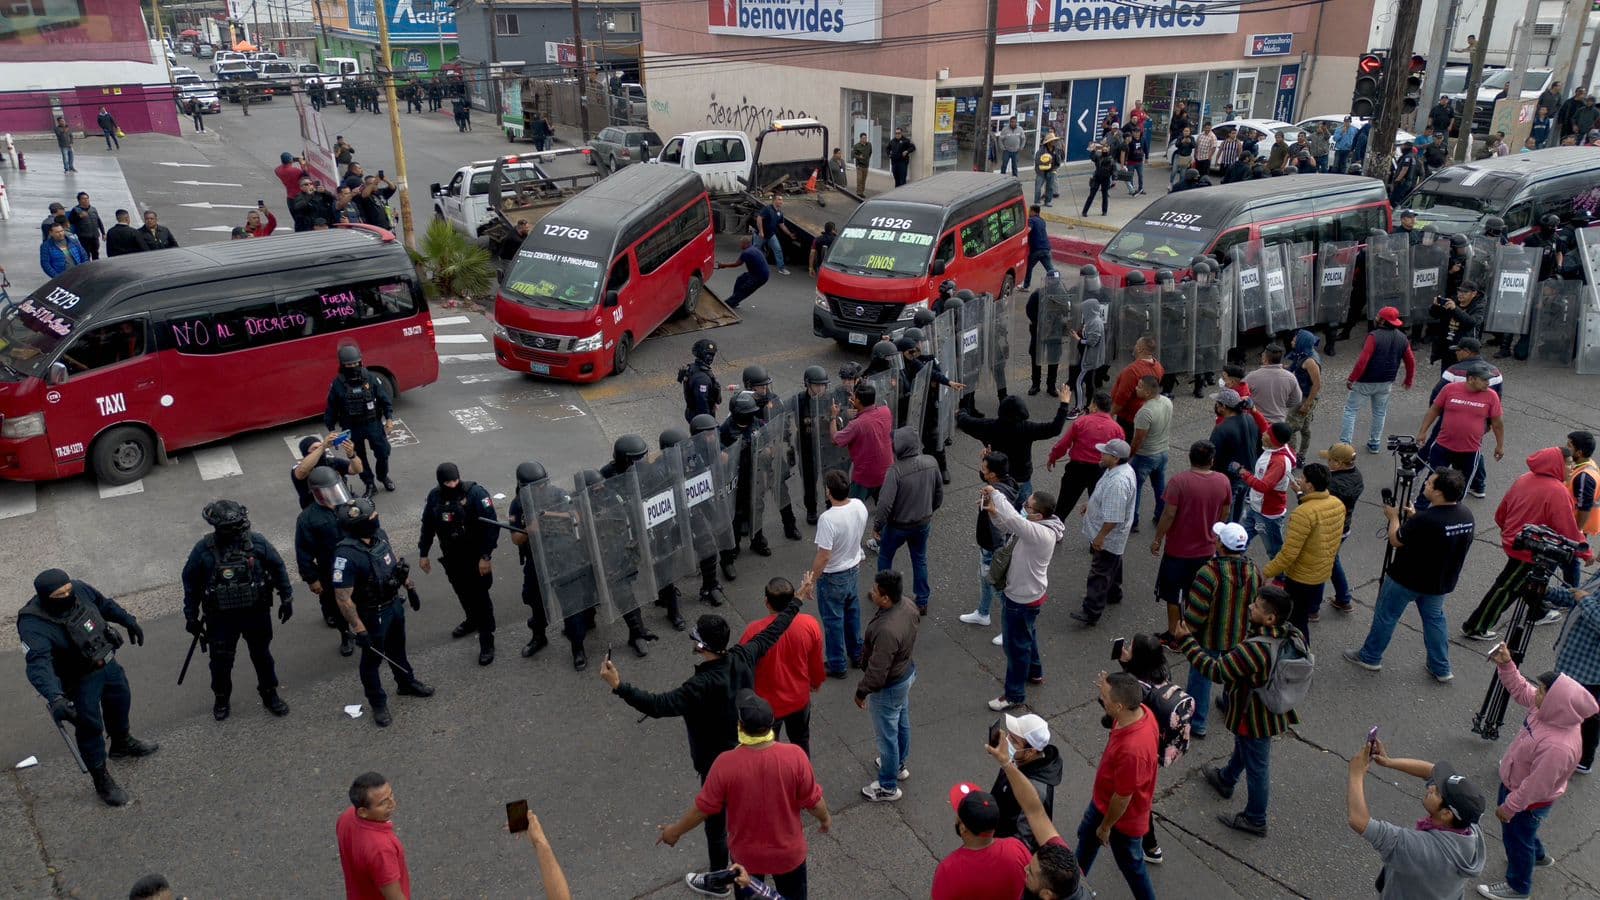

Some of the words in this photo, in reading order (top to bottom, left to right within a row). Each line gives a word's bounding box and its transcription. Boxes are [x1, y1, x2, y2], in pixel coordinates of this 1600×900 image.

[739, 0, 843, 33] benavides
[1054, 0, 1205, 32] benavides
[870, 216, 912, 229] 11926
[1160, 211, 1202, 224] 17597
[543, 224, 589, 240] 12768
[898, 232, 934, 246] CENTRO
[866, 255, 896, 270] PINOS
[1324, 272, 1343, 282] POLICIA
[1415, 272, 1436, 283] POLICIA
[1502, 277, 1525, 288] POLICIA
[46, 286, 80, 310] 13279
[172, 320, 210, 347] NO
[216, 323, 236, 338] AL
[245, 313, 306, 335] DECRETO
[96, 392, 126, 416] TAXI
[685, 479, 711, 499] POLICIA
[647, 497, 672, 521] POLICIA
